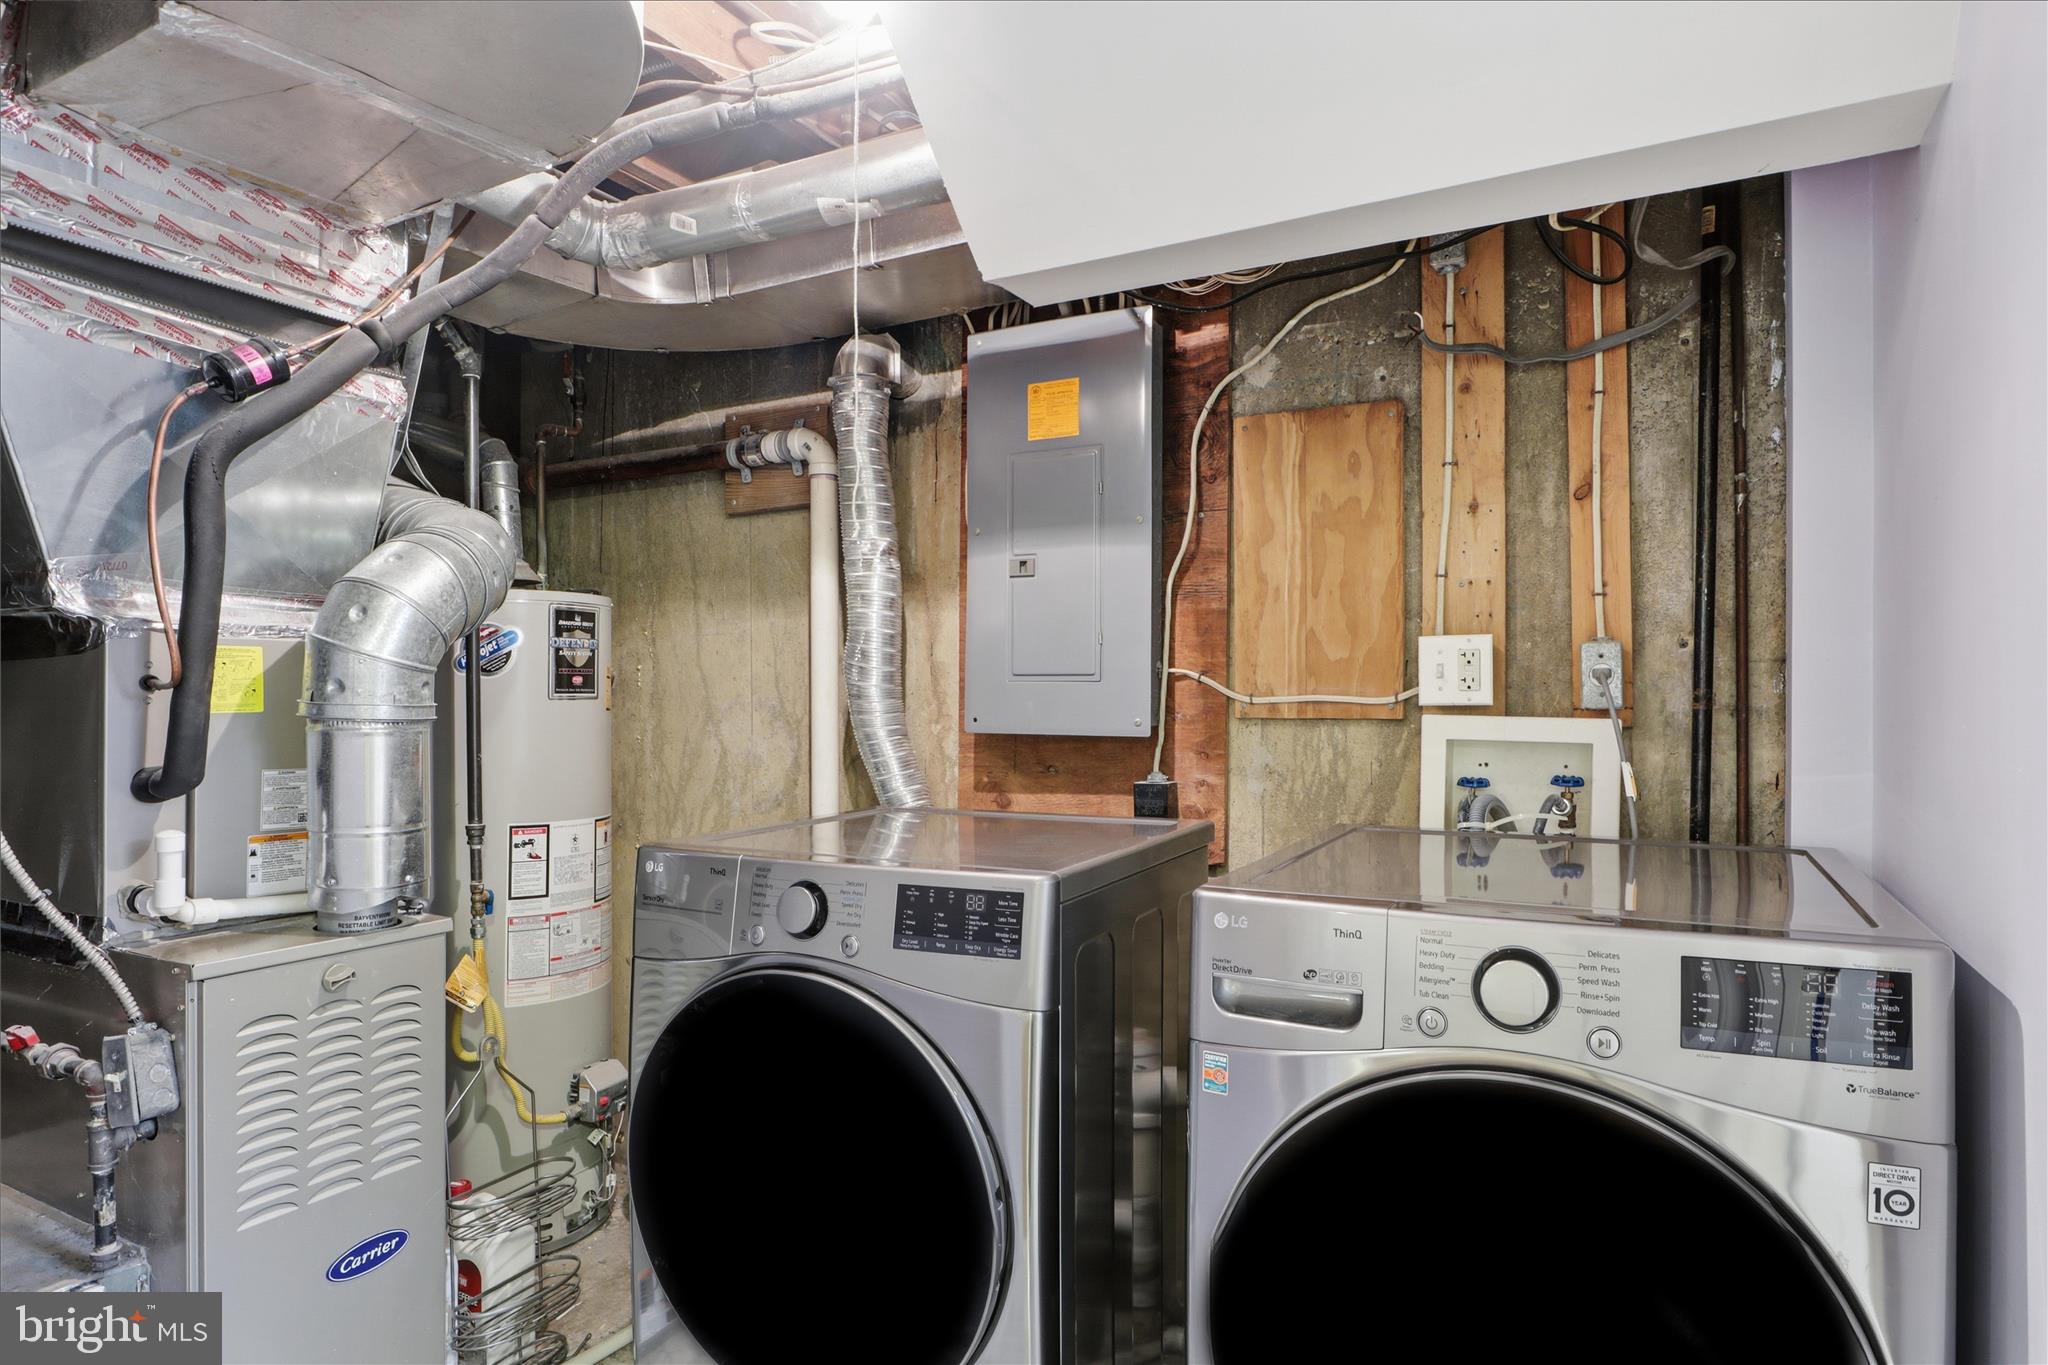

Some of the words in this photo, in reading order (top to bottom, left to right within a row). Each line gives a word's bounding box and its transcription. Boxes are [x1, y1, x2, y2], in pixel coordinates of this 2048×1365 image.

[653, 863, 664, 872] LG
[710, 867, 726, 876] ThinQ
[1231, 915, 1248, 928] LG
[1333, 928, 1363, 940] ThinQ
[1420, 937, 1443, 945] Normal
[1419, 950, 1439, 960] Heavy
[1440, 951, 1456, 961] Duty
[1587, 950, 1620, 960] Delicates
[1419, 962, 1445, 972] Bedding
[1600, 965, 1620, 974] Press
[1577, 977, 1599, 986] Speed
[1601, 978, 1620, 987] Wash
[1419, 990, 1430, 998] Tub
[1431, 992, 1449, 1000] Clean
[1577, 1006, 1620, 1018] Downloaded
[1882, 1004, 1900, 1013] Wash
[1866, 1027, 1896, 1037] Pre-wash
[1863, 1051, 1880, 1059] Extra
[1881, 1053, 1900, 1061] Rinse
[1873, 1171, 1895, 1179] DIRECT
[1897, 1174, 1916, 1182] DRIVE
[1873, 1187, 1915, 1217] 10
[340, 1237, 399, 1274] Carrier
